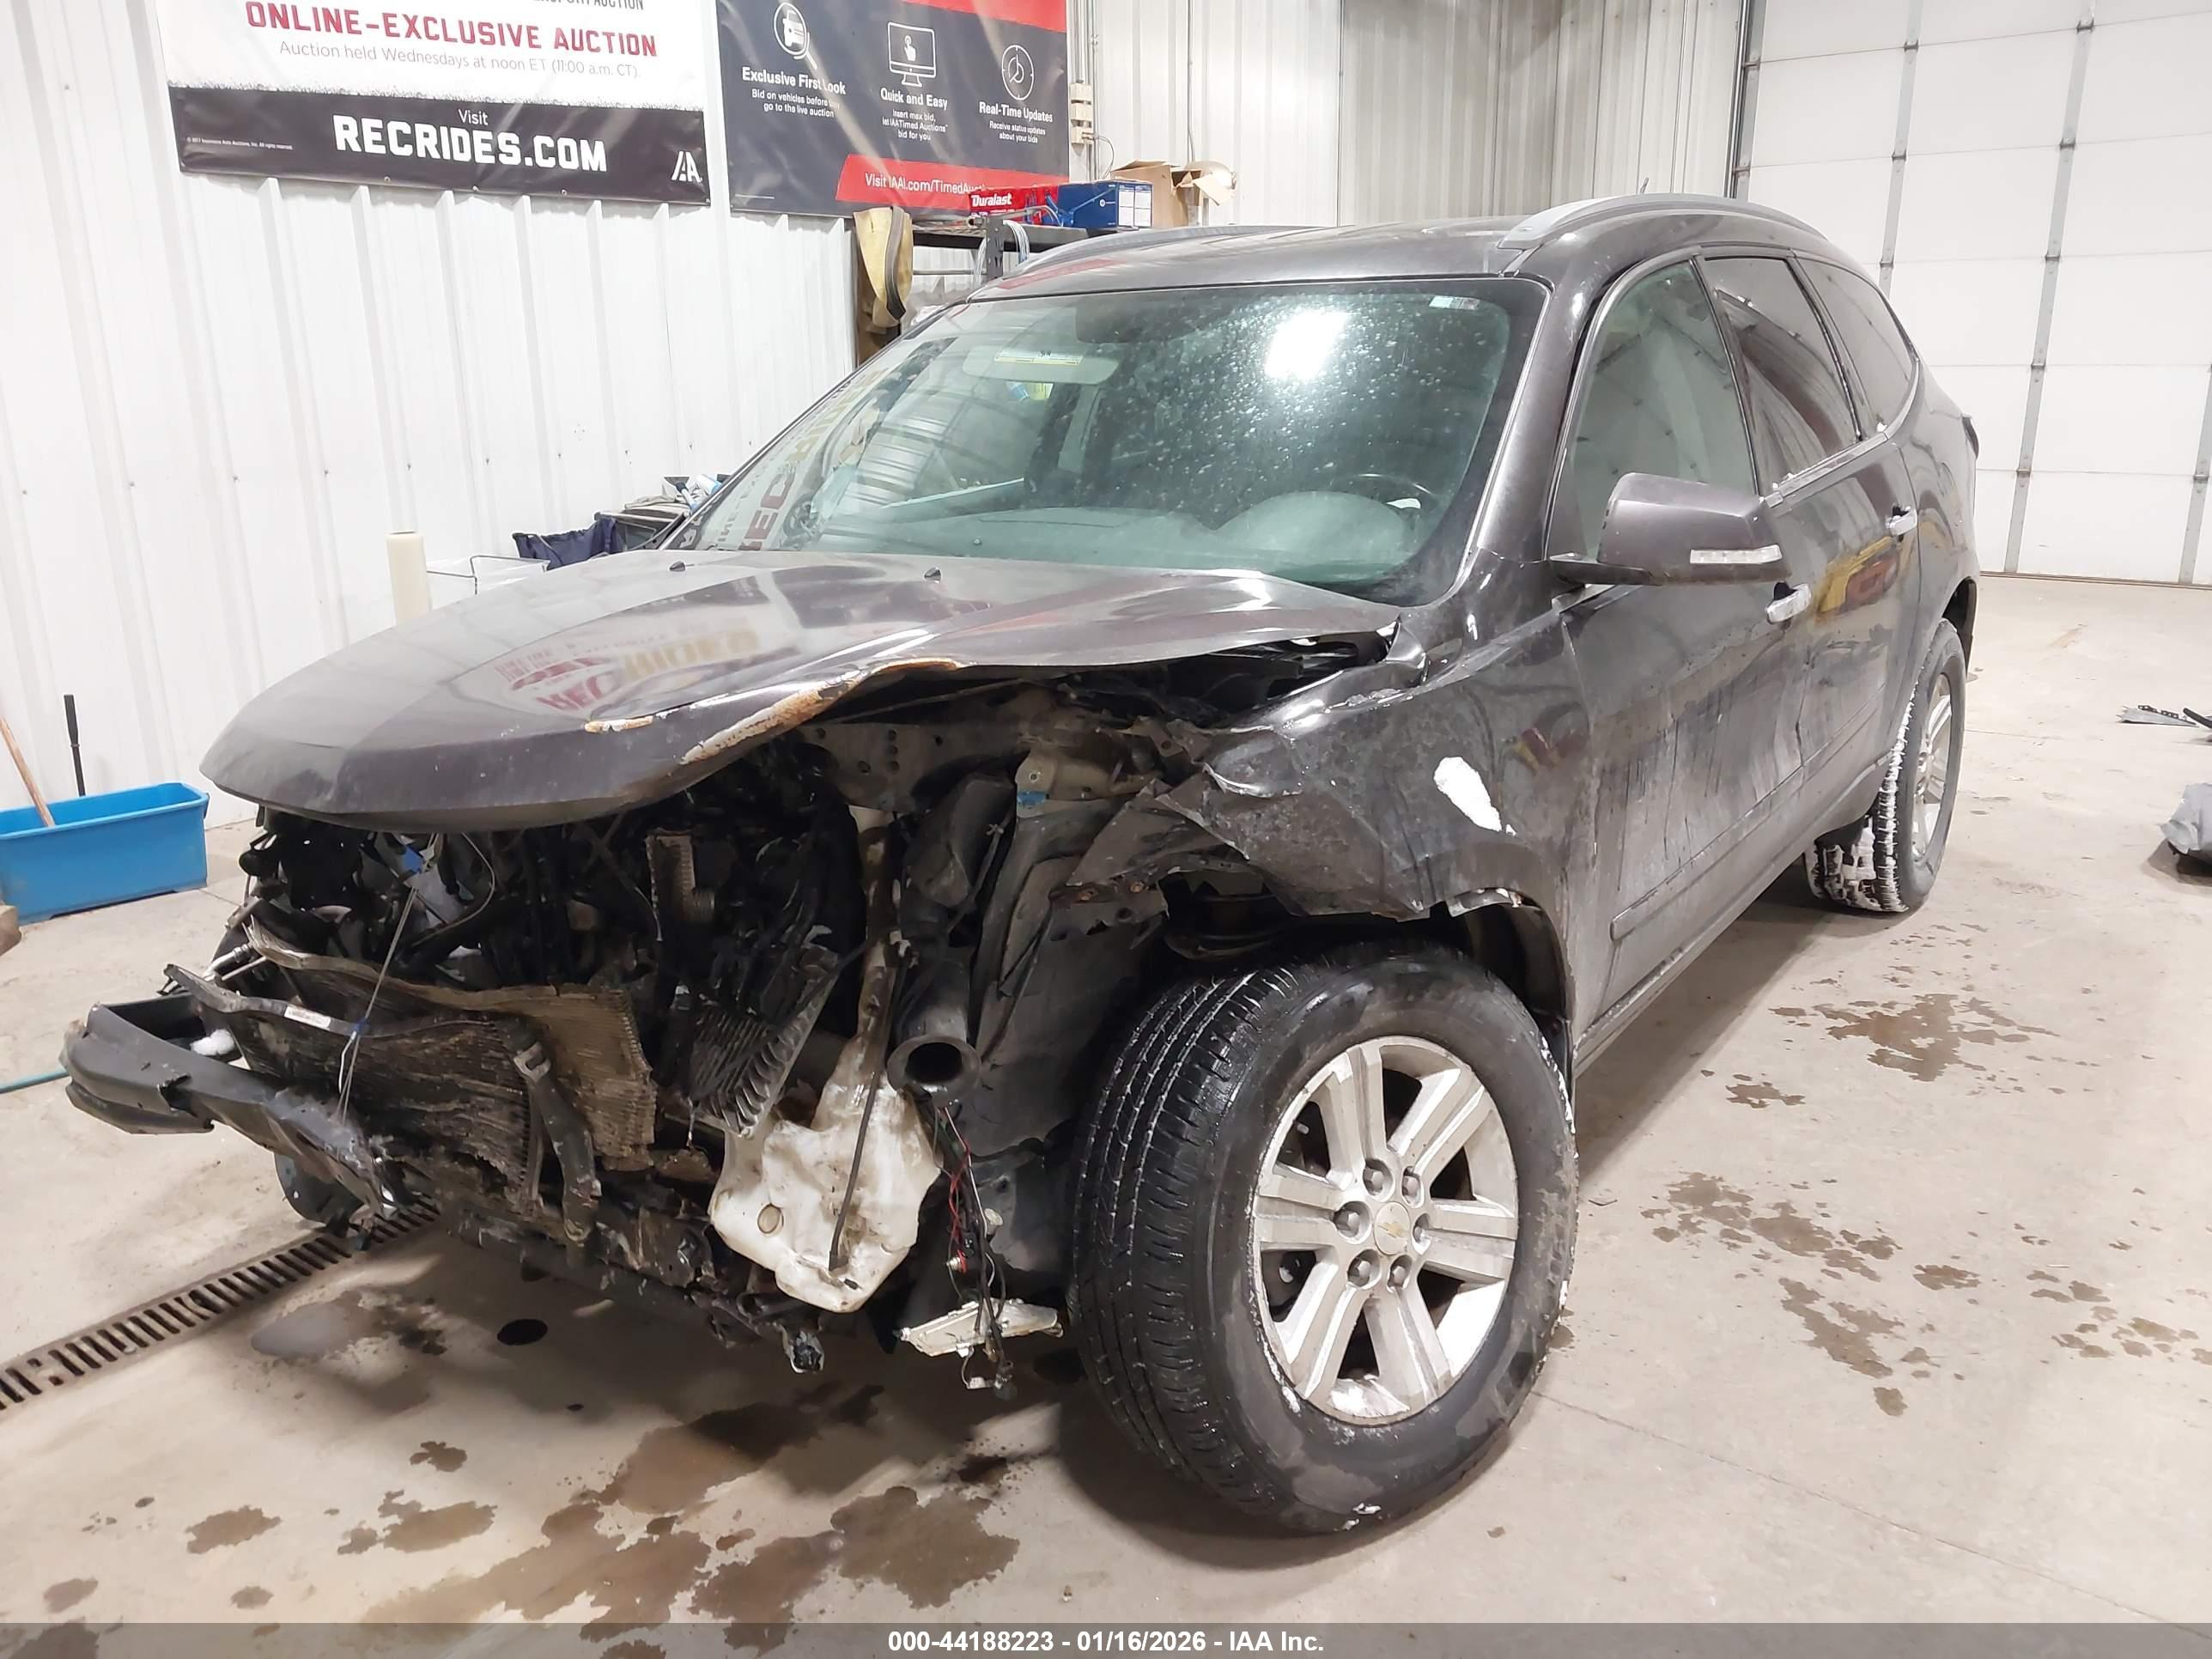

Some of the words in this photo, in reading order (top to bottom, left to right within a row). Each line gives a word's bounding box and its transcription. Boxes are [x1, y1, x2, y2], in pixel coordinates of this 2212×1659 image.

[246, 1, 542, 49] ONLINE-EXCLUSIVE
[554, 27, 658, 57] AUCTION
[280, 40, 340, 58] Auction
[344, 44, 377, 60] held
[381, 47, 469, 69] Wednesdays
[473, 56, 487, 69] at
[490, 58, 526, 70] noon
[529, 58, 547, 70] ET
[551, 59, 585, 74] (11:00
[588, 64, 613, 76] a.m.
[742, 66, 796, 87] Exclusive
[799, 73, 822, 90] First
[751, 88, 765, 99] Bid
[766, 92, 777, 100] on
[778, 93, 805, 103] vehicles
[806, 95, 830, 106] before
[880, 87, 904, 103] Quick
[906, 94, 924, 106] and
[926, 94, 948, 110] Easy
[458, 109, 489, 126] Visit
[763, 102, 774, 112] go
[775, 103, 783, 112] to
[784, 104, 796, 113] the
[796, 105, 808, 115] live
[809, 107, 835, 118] auction
[892, 109, 908, 118] Insert
[979, 101, 1022, 118] Real-Time
[1023, 106, 1054, 123] Updates
[989, 120, 1011, 131] Receive
[1012, 125, 1027, 133] status
[332, 114, 608, 173] RECRIDES.COM
[897, 129, 908, 138] bid
[908, 131, 918, 140] for
[919, 133, 932, 142] you
[999, 131, 1015, 140] about
[1015, 134, 1027, 143] your
[865, 173, 887, 187] Visit
[970, 192, 1012, 207] Duralast
